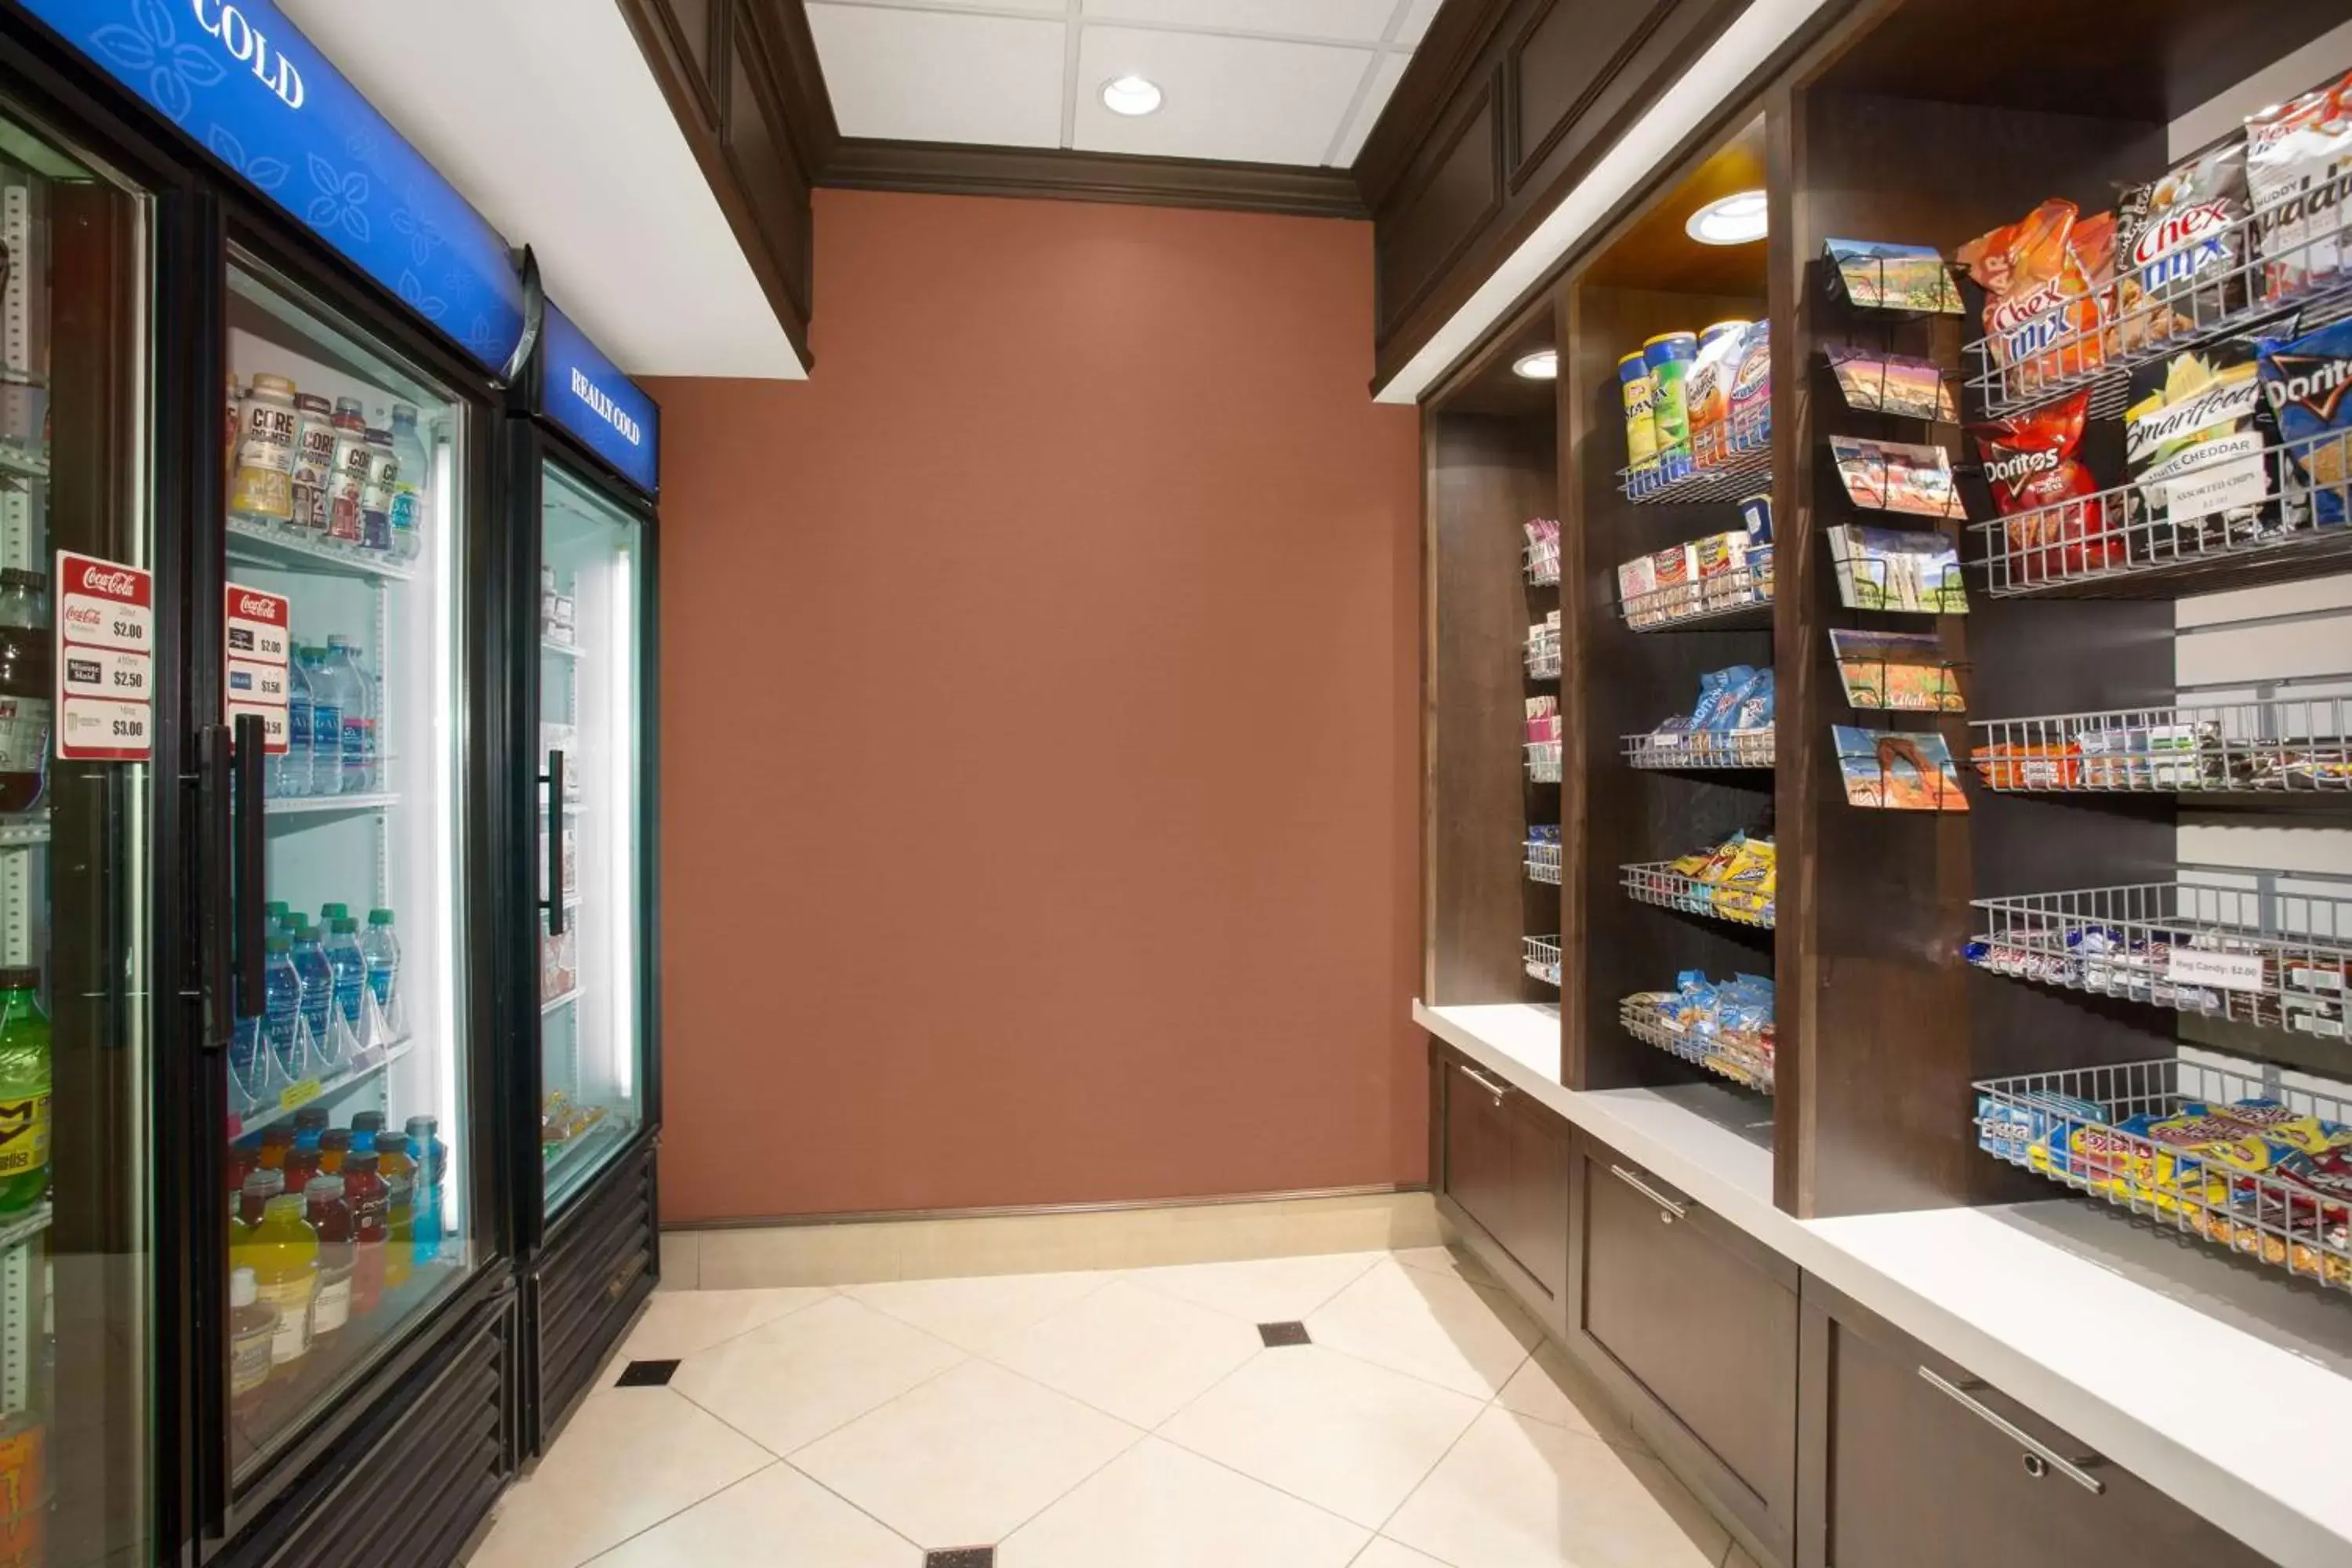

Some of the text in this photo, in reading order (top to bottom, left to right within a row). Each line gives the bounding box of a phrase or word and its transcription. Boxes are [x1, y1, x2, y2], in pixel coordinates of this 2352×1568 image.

[193, 0, 304, 109] COLD
[2136, 198, 2231, 263] Chex
[1994, 278, 2065, 331] Chex
[2265, 359, 2352, 408] Dorit
[252, 408, 295, 434] CORE
[571, 367, 641, 446] REALLY COLD
[2126, 382, 2260, 456] Smartfood
[1984, 448, 2059, 484] Doritos
[2181, 440, 2250, 465] CHEDDAR
[82, 565, 135, 597] Coca-Cola
[112, 620, 143, 639] $2.00
[261, 639, 281, 654] $2.00
[113, 670, 143, 688] $2.50
[112, 720, 143, 737] $3.00
